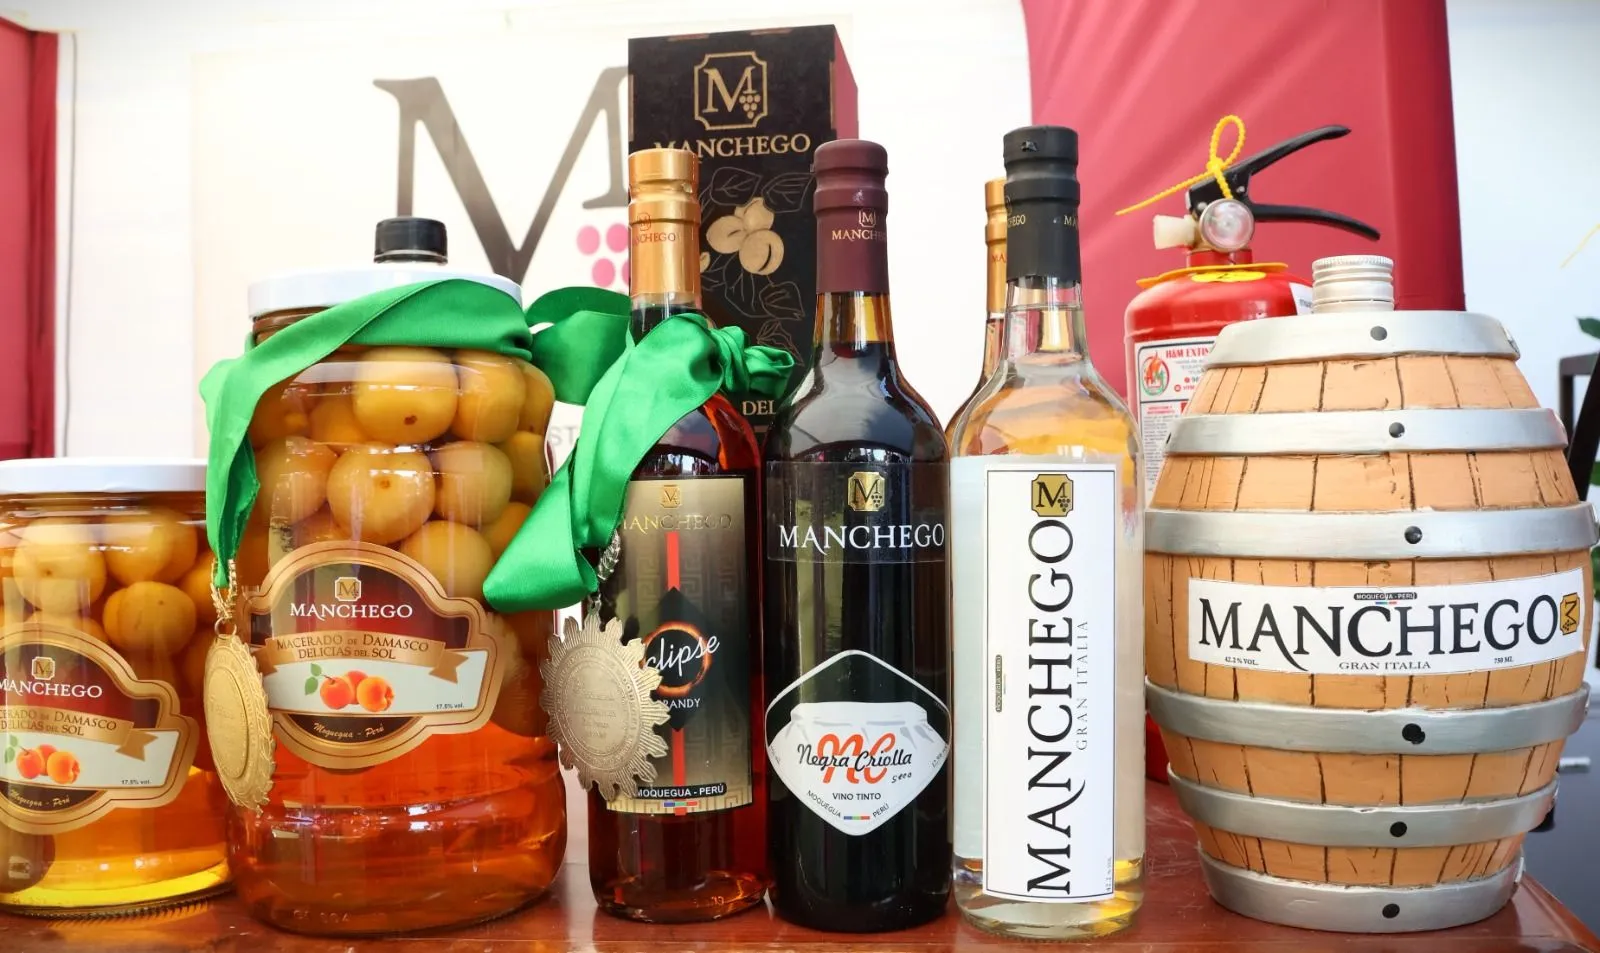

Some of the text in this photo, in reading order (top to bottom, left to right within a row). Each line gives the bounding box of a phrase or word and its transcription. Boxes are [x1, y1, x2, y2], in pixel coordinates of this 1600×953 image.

[779, 523, 945, 556] MANCHEGO
[290, 602, 413, 621] MANCHEGO
[1199, 594, 1558, 671] MANCHEGO
[276, 634, 343, 650] MACERADO
[363, 633, 429, 652] DAMASCO
[298, 646, 351, 659] DELICIAS
[372, 648, 396, 660] SOL
[645, 635, 720, 677] clipse
[1339, 661, 1432, 670] GRAN ITALIA
[1076, 621, 1088, 751] GRAN ITALIA
[1027, 519, 1086, 896] MANCHEGO
[54, 711, 117, 731] DAMASCO
[61, 724, 84, 736] SOL
[797, 743, 850, 771] Negra
[854, 748, 912, 773] Criolla
[699, 783, 724, 795] PERÚ
[832, 792, 882, 801] VINO TINTO
